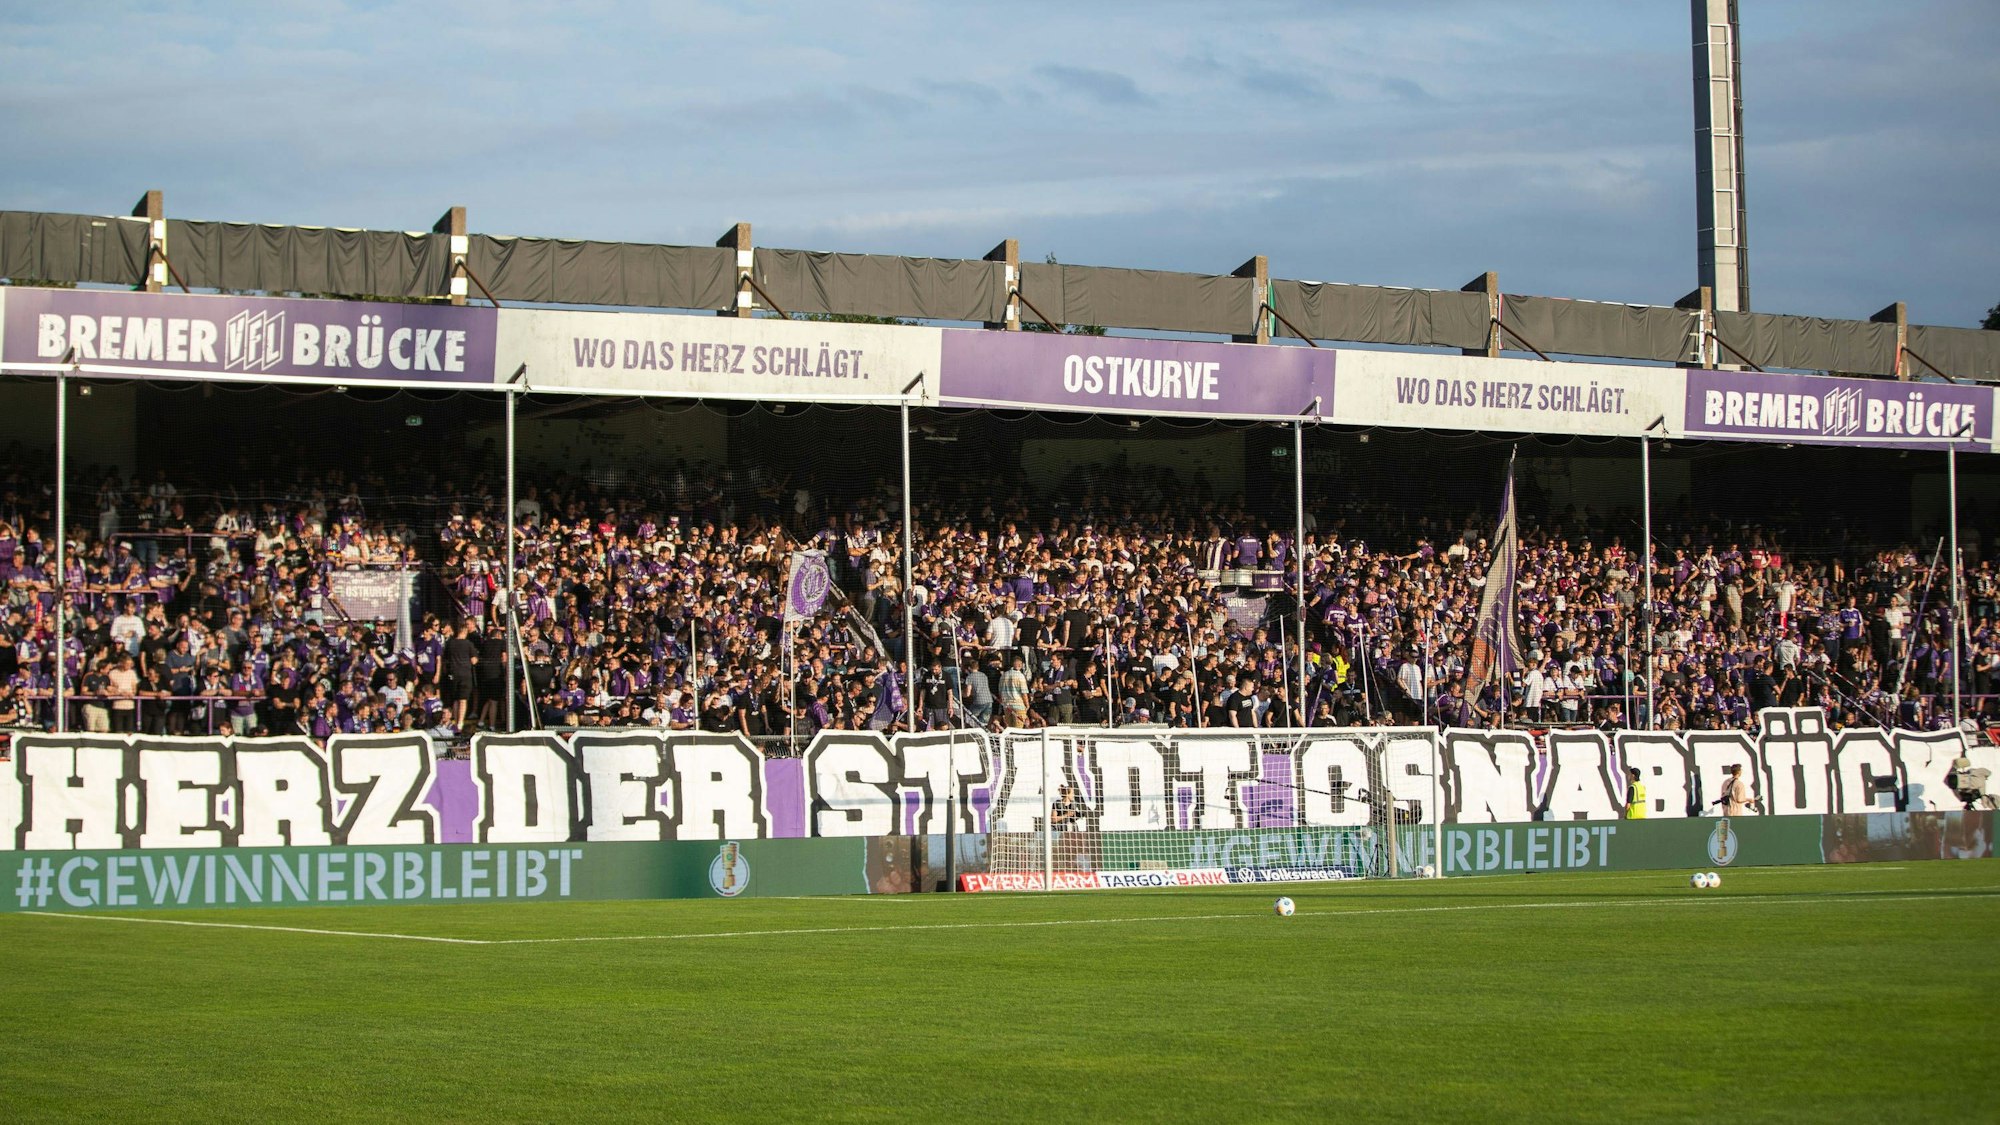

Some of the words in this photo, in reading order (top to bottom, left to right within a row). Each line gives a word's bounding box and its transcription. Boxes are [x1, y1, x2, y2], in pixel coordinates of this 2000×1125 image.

[38, 313, 218, 364] BREMER
[292, 314, 466, 373] BRÜCKE
[573, 337, 615, 368] WO
[622, 339, 674, 371] DAS
[681, 342, 747, 375] HERZ
[752, 342, 869, 380] SCHLÄGT.
[1063, 354, 1220, 400] OSTKURVE
[1396, 376, 1430, 404] WO
[1435, 378, 1477, 407] DAS
[1481, 381, 1532, 410] HERZ
[1537, 381, 1629, 415] SCHLÄGT.
[1704, 390, 1819, 430] BREMER
[1866, 392, 1976, 437] BRÜCKE
[17, 737, 437, 850] HERZ
[477, 735, 765, 842] DER
[807, 731, 1259, 837] STADT
[1295, 709, 1970, 828] OSNABRÜCK
[15, 849, 582, 907] #GEWINNERBLEIBT
[1261, 867, 1345, 883] Volkswagen
